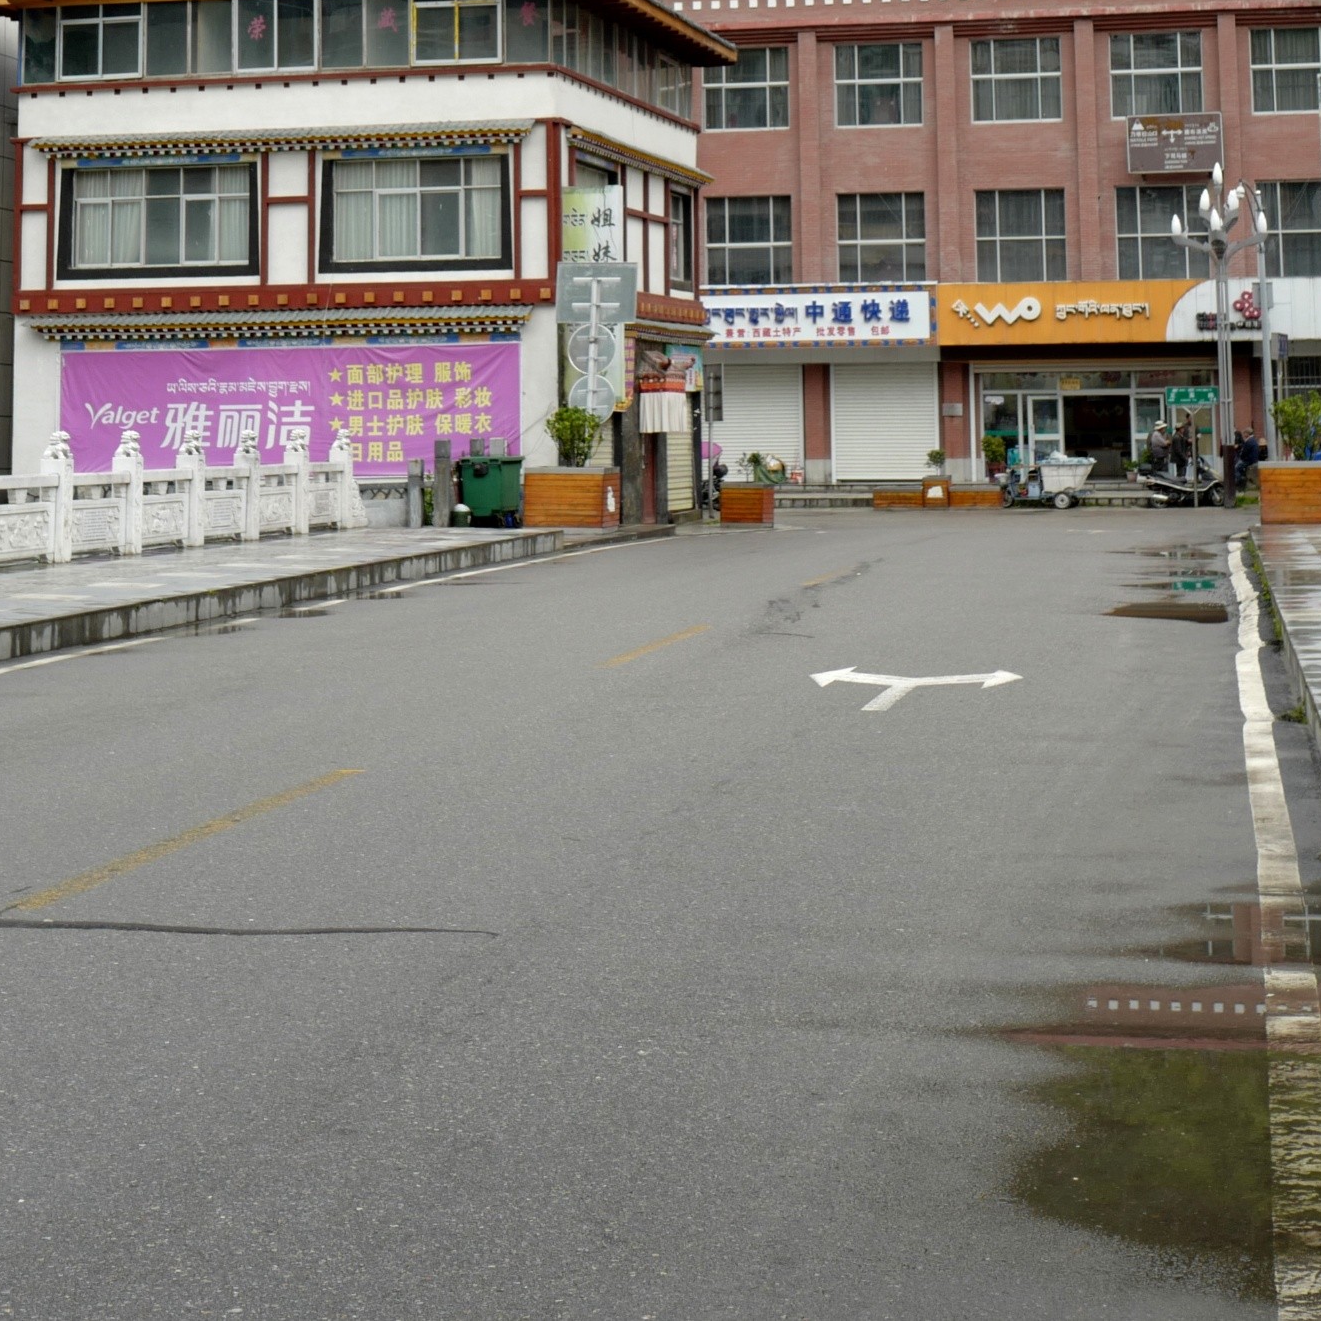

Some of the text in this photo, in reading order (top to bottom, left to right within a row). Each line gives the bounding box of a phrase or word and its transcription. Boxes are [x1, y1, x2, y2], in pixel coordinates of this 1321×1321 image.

[591, 207, 617, 263] 姐妹
[805, 298, 911, 325] 中通快递
[346, 361, 472, 385] 面部护理 服饰
[347, 386, 493, 411] 进口品护肤 彩妆
[85, 402, 159, 429] Yalget
[160, 399, 315, 449] 雅丽洁
[348, 412, 493, 437] 男士护肤 保暖衣
[351, 441, 404, 463] 日用品
